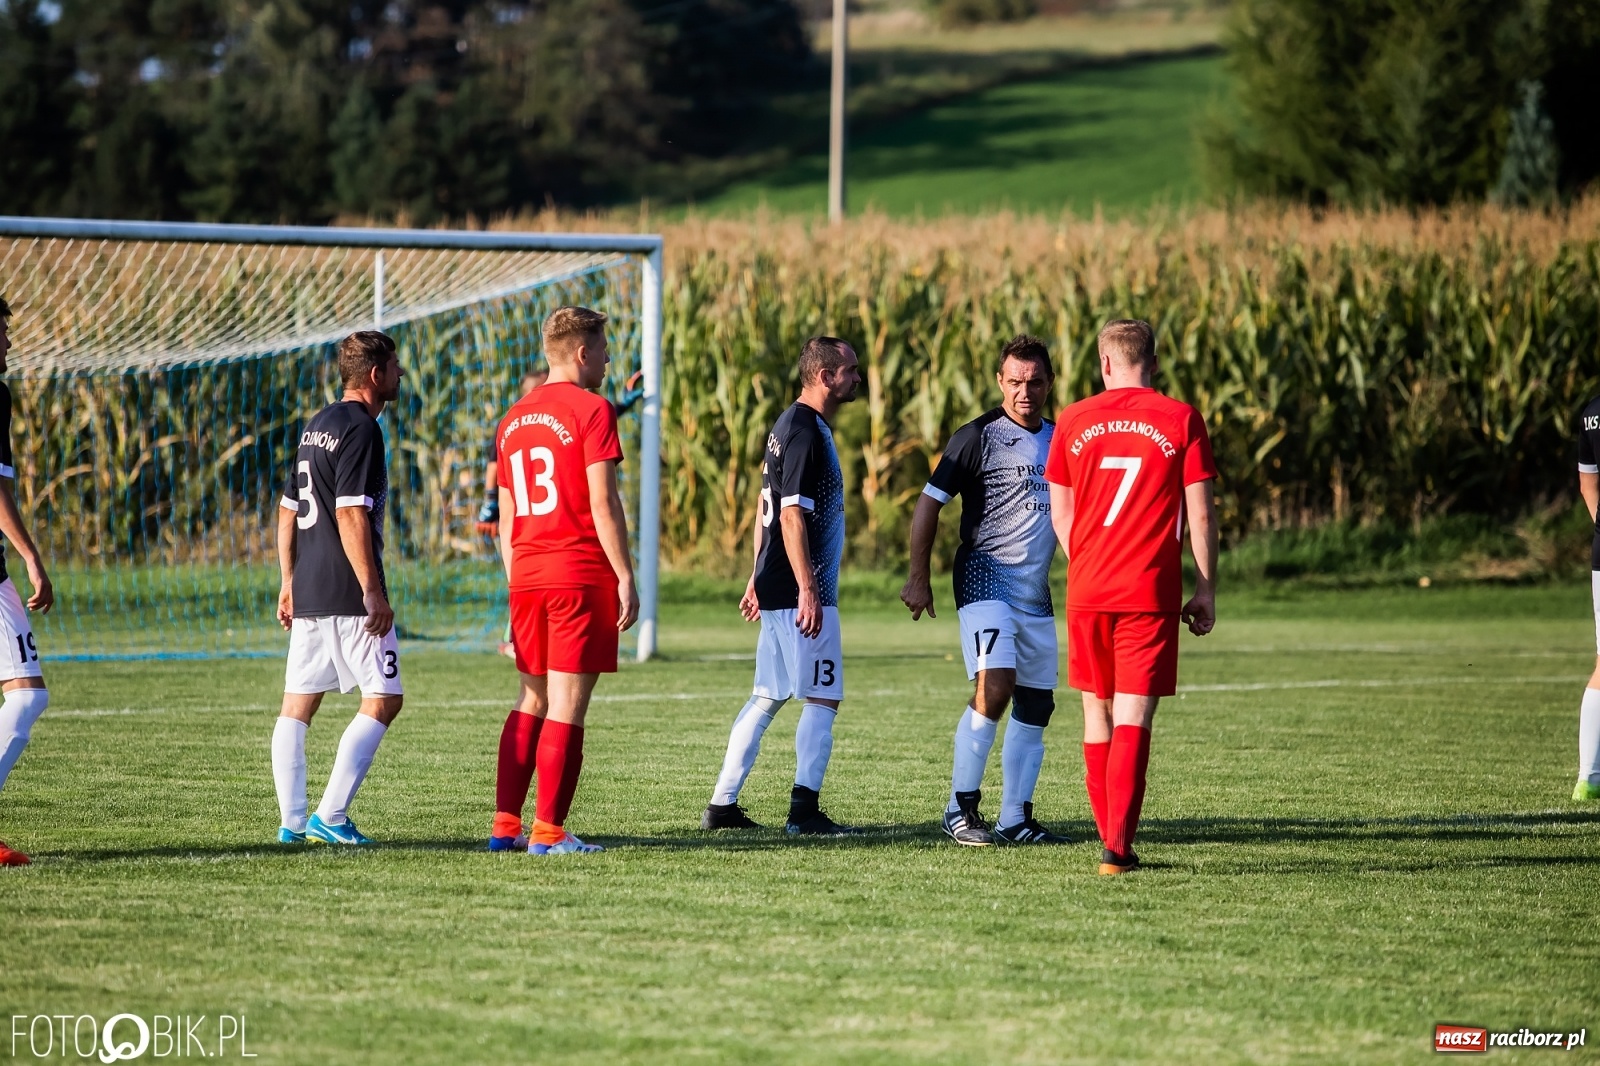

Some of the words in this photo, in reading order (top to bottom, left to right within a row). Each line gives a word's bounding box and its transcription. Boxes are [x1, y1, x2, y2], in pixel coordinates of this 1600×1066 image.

[521, 412, 574, 446] KRZANOWICE
[1070, 438, 1084, 457] KS
[1081, 422, 1106, 443] 1905
[1107, 420, 1176, 458] KRZANOWICE
[296, 460, 319, 530] 3
[509, 446, 559, 518] 13
[1099, 456, 1143, 527] 7
[16, 631, 38, 663] 19
[974, 628, 1001, 658] 17
[384, 650, 398, 679] 3
[813, 659, 835, 687] 13
